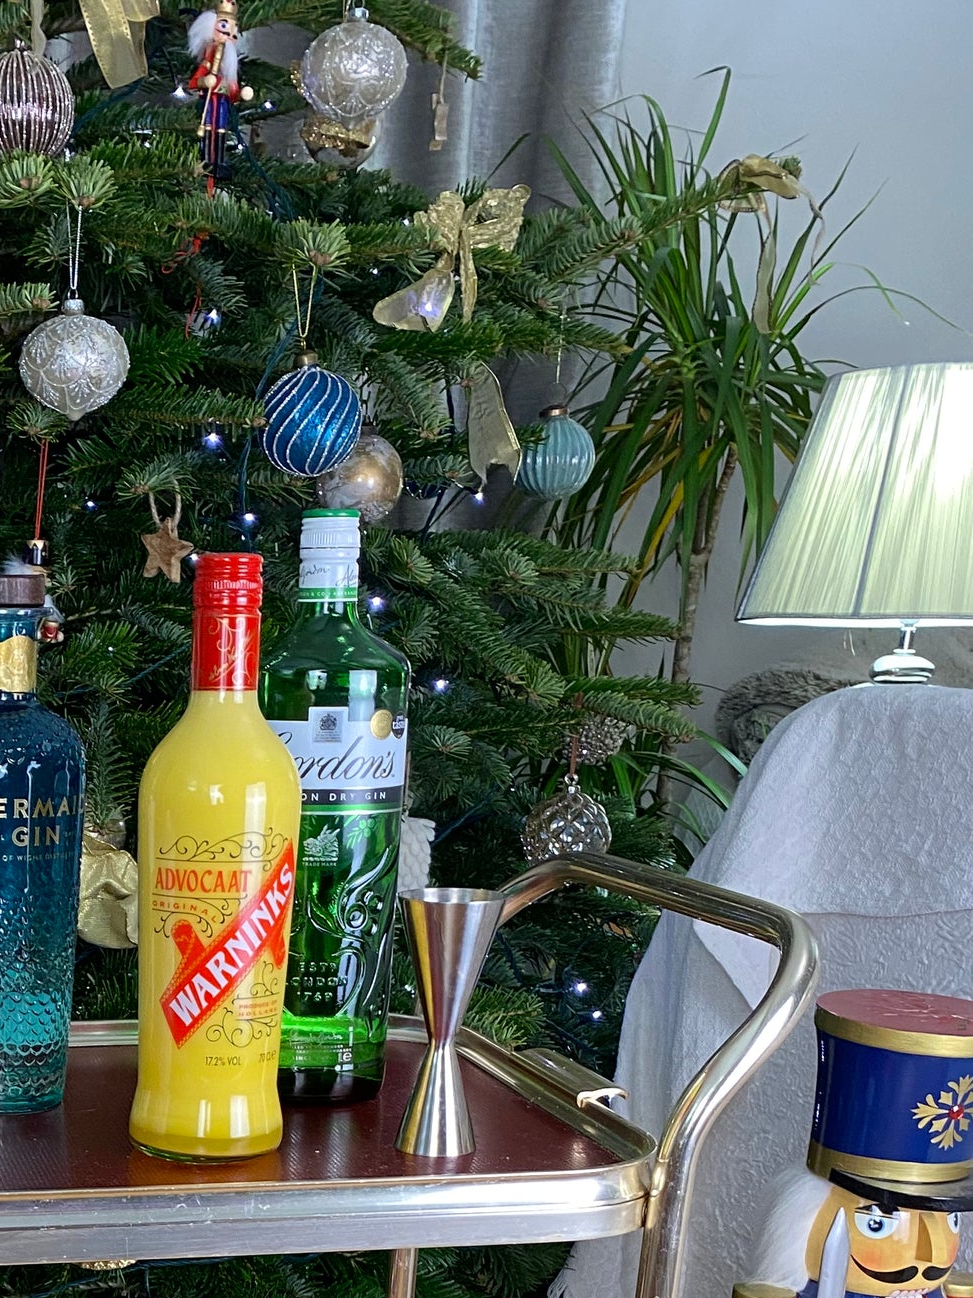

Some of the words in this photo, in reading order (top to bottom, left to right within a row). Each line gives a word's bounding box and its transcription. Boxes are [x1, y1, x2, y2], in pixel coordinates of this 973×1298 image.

[329, 793, 357, 802] DRY
[364, 791, 387, 801] GIN
[11, 825, 61, 847] GIN
[2, 854, 14, 862] OF
[154, 866, 253, 894] ADVOCAAT
[151, 900, 217, 924] ORIGINAL
[169, 863, 294, 1027] WARNINKS
[205, 1056, 226, 1066] 17.2%
[226, 1056, 242, 1066] VOL
